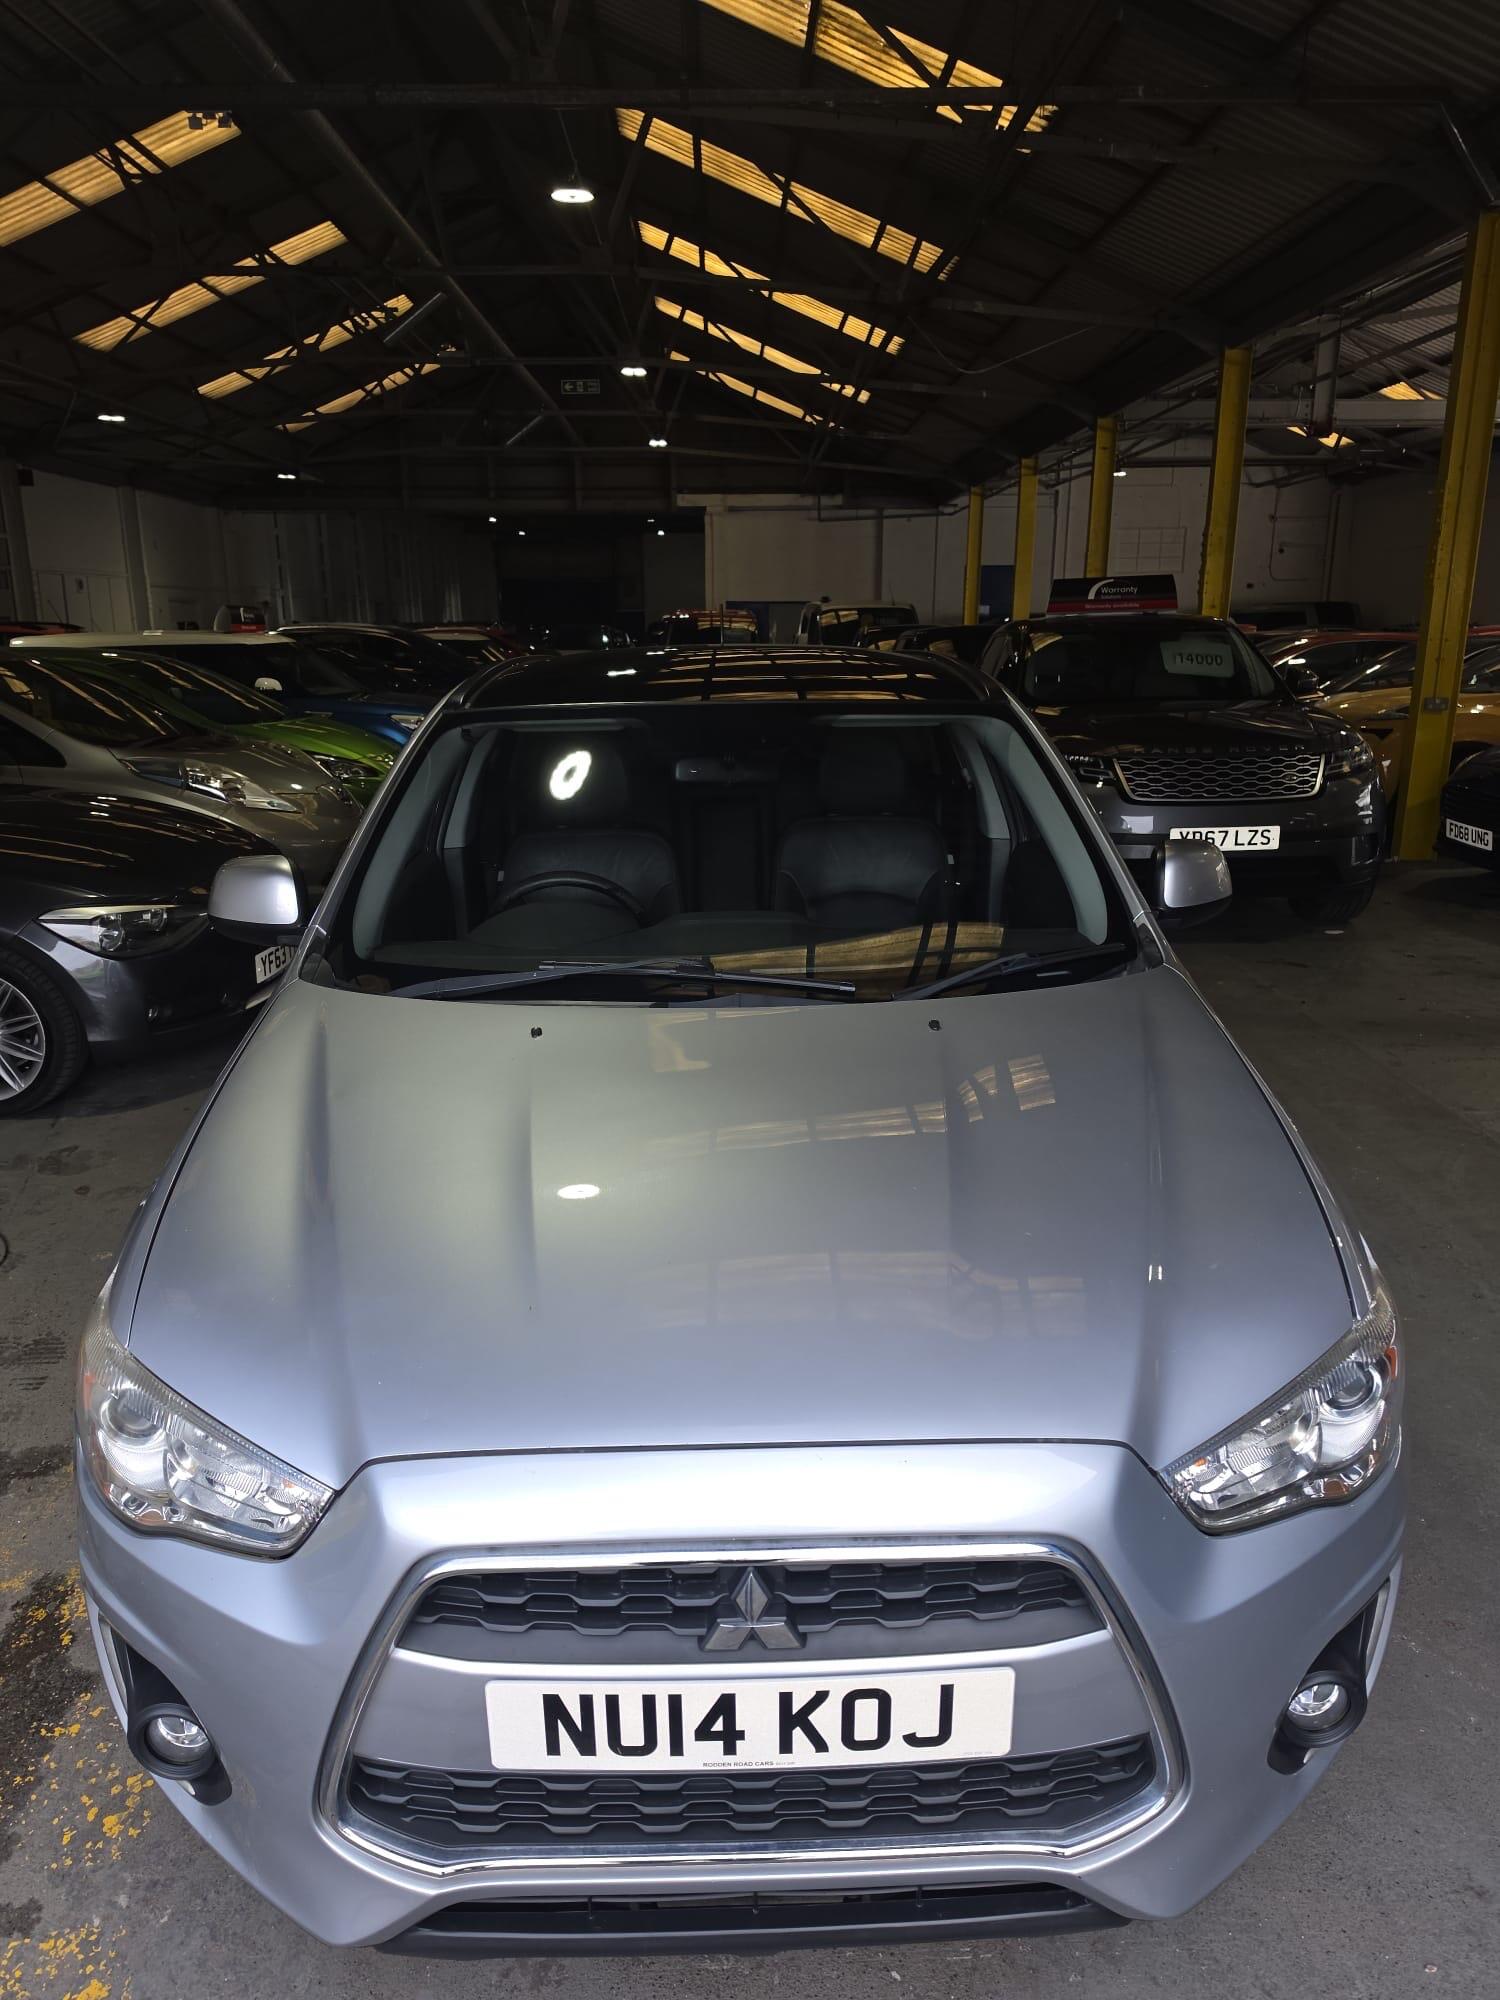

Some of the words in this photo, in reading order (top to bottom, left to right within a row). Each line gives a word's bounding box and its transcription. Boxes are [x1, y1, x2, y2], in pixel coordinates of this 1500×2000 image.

[1101, 586, 1138, 594] Warranty
[1234, 829, 1272, 846] LZS
[1449, 822, 1469, 841] FD68
[1471, 828, 1489, 847] UNG
[260, 944, 287, 977] YF63
[542, 1692, 746, 1757] NU14
[778, 1683, 955, 1755] KOJ
